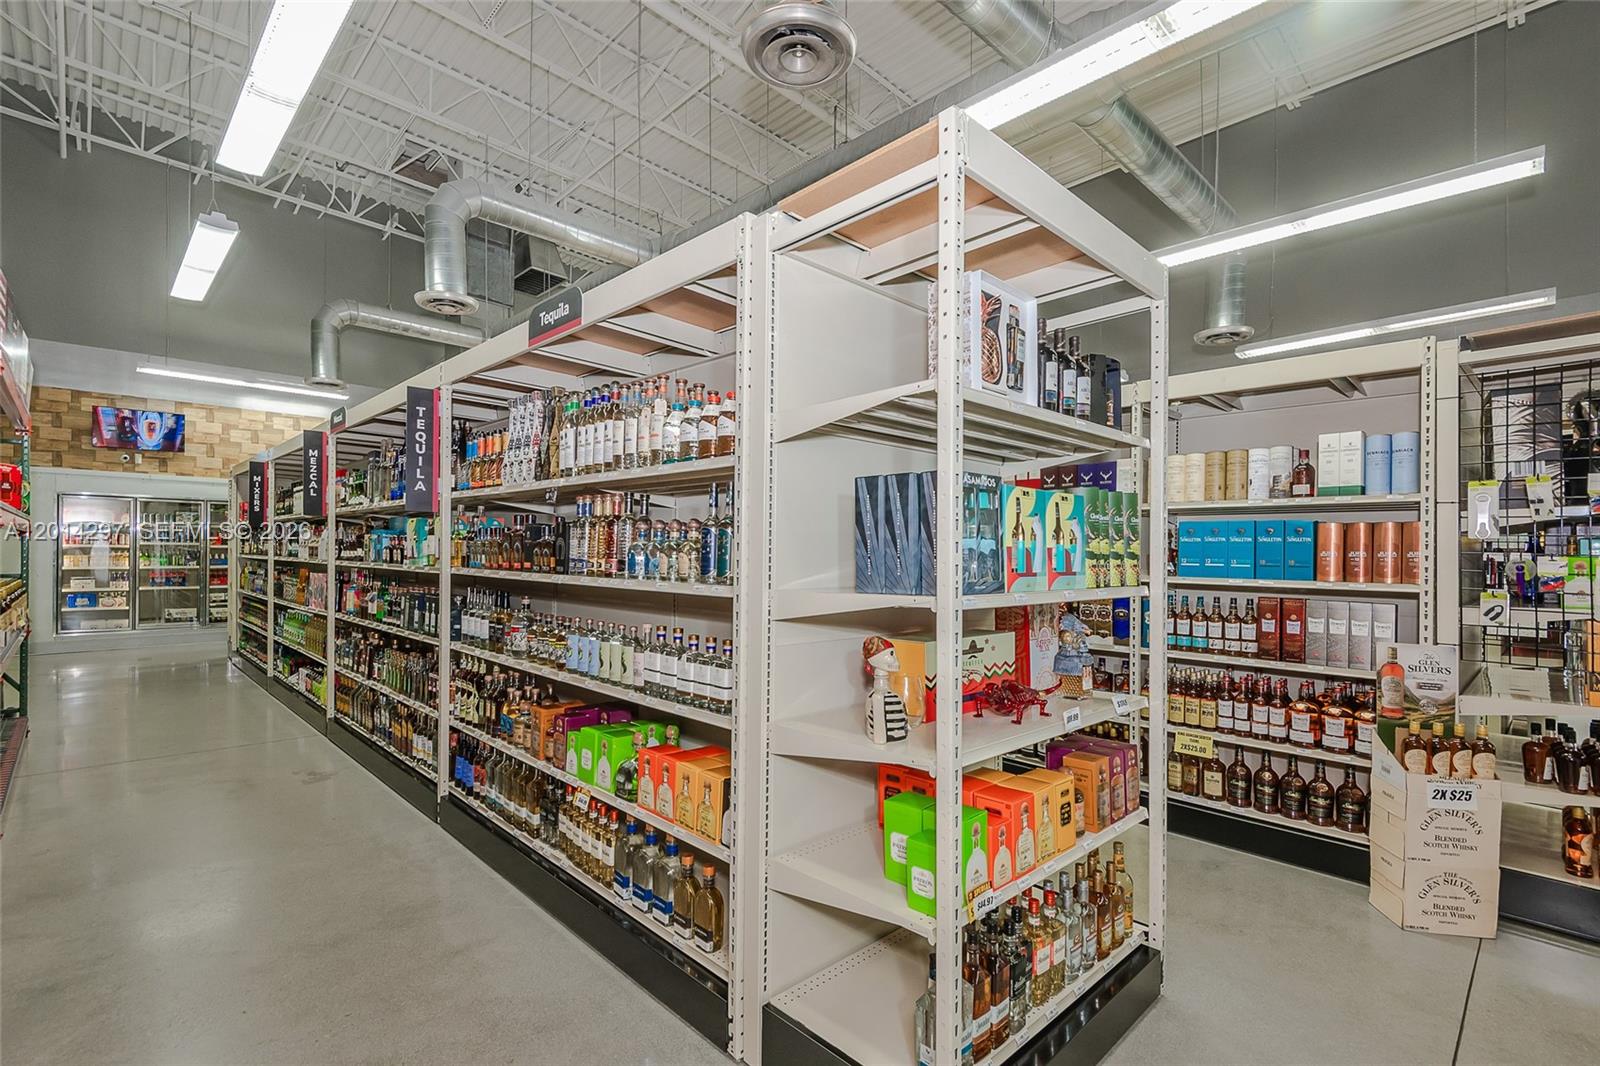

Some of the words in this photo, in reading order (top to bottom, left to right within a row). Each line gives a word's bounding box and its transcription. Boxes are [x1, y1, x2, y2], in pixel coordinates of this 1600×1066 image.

[538, 302, 570, 326] Tequila
[414, 406, 427, 491] TEQUILA
[308, 448, 318, 497] MEZCAL
[253, 475, 262, 512] MIXERS
[1432, 789, 1448, 801] 2X
[1449, 789, 1473, 801] $25
[1420, 811, 1442, 831] GLEN
[1444, 808, 1483, 836] SILVER'S
[1434, 834, 1468, 843] BLENDED
[1418, 879, 1441, 900] GLEN
[1443, 878, 1481, 905] SILVER'S
[1433, 903, 1466, 912] BLENDED
